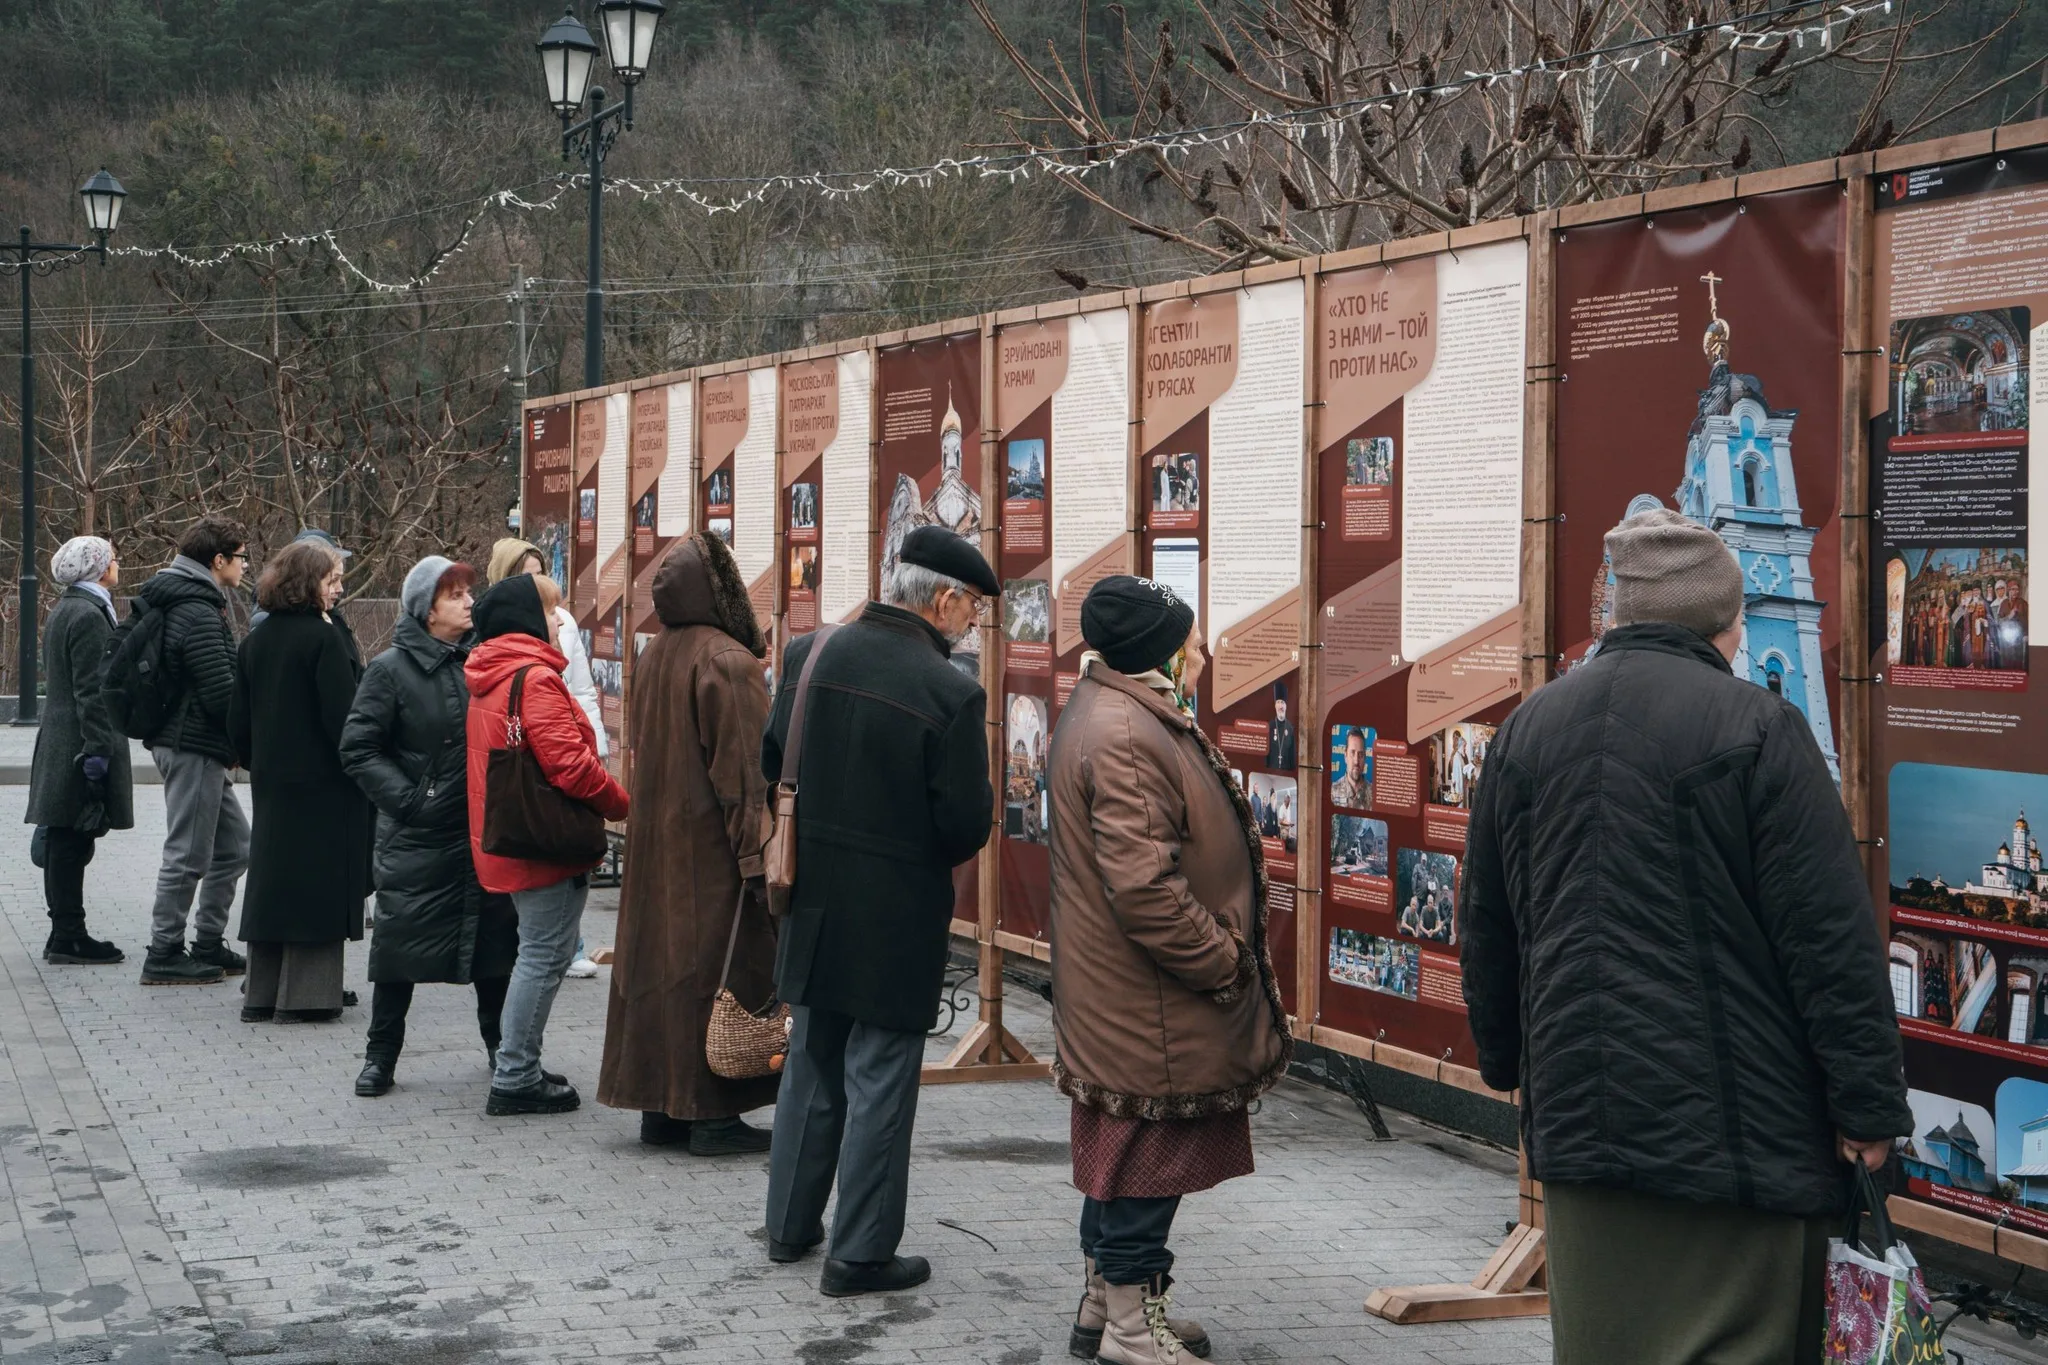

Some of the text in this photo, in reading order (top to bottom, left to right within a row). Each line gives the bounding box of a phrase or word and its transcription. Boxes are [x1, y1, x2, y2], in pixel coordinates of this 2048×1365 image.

[1329, 291, 1389, 318] «ХТО НЕ
[1149, 322, 1193, 345] АГЕНТИ
[1328, 329, 1337, 349] З
[1340, 323, 1382, 348] НАМИ
[1398, 311, 1428, 340] ТОЙ
[1004, 340, 1062, 364] ЗРУЙНОВАНІ
[1148, 344, 1232, 372] КОЛАБОРАНТИ
[1329, 350, 1418, 380] ПРОТИ НАС»
[788, 370, 836, 392] МОСКОВСЬКИЙ
[1004, 368, 1035, 388] ХРАМИ
[1147, 376, 1195, 399] У РЯСАХ
[789, 395, 826, 412] ПАТРІАРХАТ
[794, 415, 812, 432] ВІЙНІ
[812, 415, 835, 431] ПРОТИ
[789, 436, 816, 453] УКРАЇНИ
[535, 442, 570, 472] ЦЕРКОВНИЙ
[544, 473, 571, 494] РАШИЗМ
